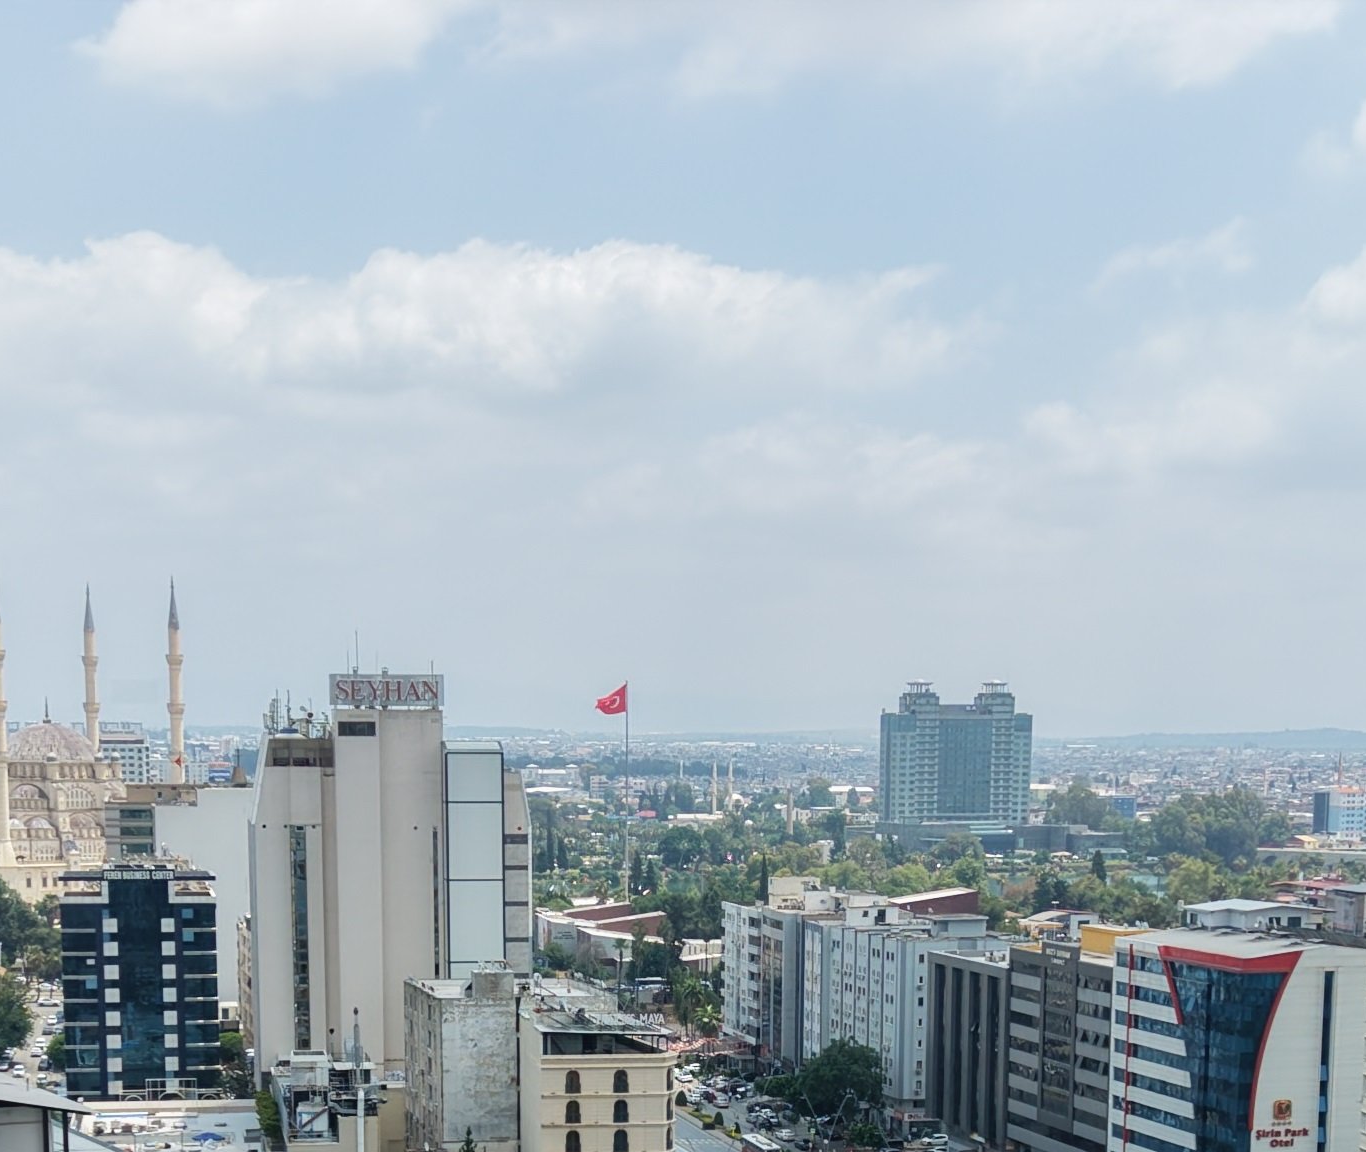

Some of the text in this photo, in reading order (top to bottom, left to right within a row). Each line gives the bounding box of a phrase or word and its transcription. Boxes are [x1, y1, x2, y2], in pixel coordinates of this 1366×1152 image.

[335, 679, 439, 701] SEYHAN
[639, 1013, 665, 1026] MAYA
[1256, 1128, 1309, 1141] Şirin Park
[1270, 1138, 1294, 1148] Otel
